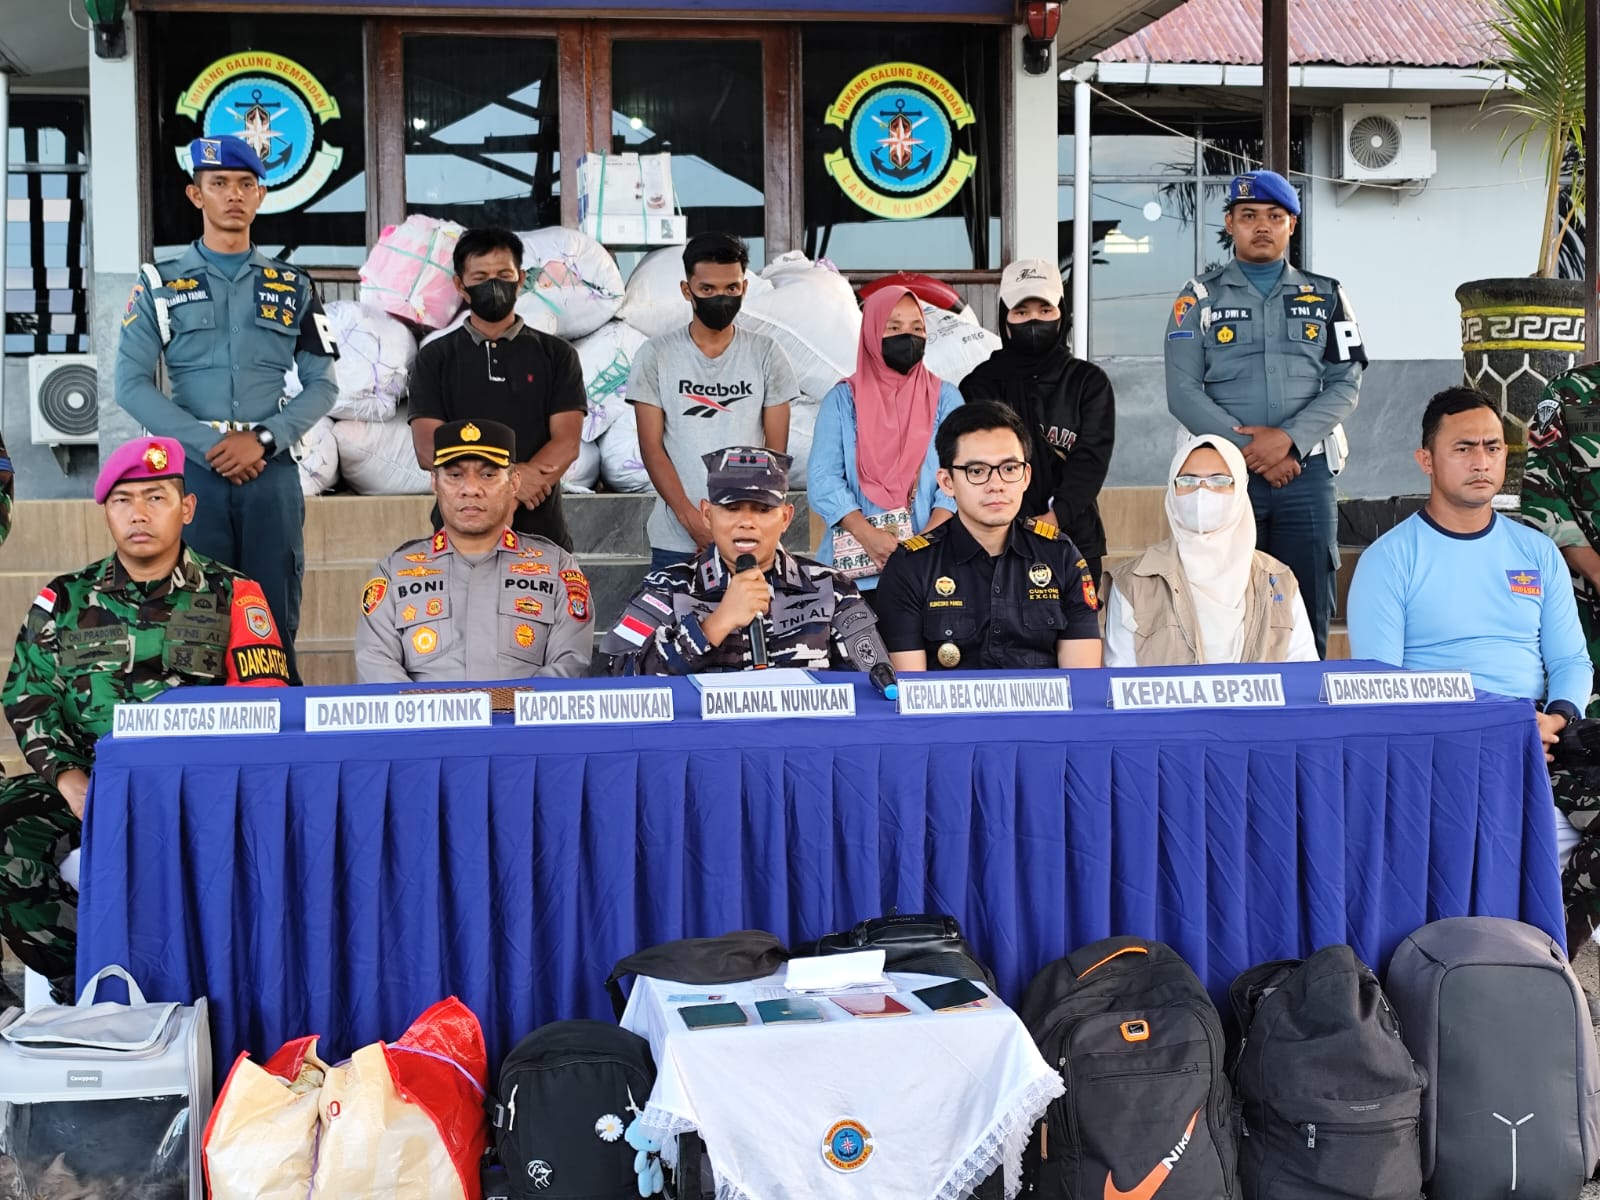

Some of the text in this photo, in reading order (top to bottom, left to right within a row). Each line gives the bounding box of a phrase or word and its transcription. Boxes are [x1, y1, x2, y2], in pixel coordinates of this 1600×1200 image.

[190, 57, 326, 109] MIKANG GALUNG SEMPADAN
[838, 67, 964, 116] MIKANG GALUNG SEMPADAN
[842, 175, 959, 215] LANAL NUNUKAN
[258, 291, 297, 311] TNI AL
[1290, 307, 1328, 320] TNI AL
[312, 313, 337, 353] P
[1334, 321, 1362, 361] P
[678, 380, 753, 397] Reebok
[397, 580, 444, 599] BONI
[505, 579, 554, 595] POLRI
[779, 607, 831, 629] TNI AL
[706, 688, 849, 715] DANLANAL NUNUKAN
[905, 681, 1064, 710] KEPALA BEA CUKAI NUNUKAN
[1122, 678, 1280, 706] KEPALA BP3MI
[1333, 676, 1471, 701] DANSATGAS KOPASKA
[117, 705, 277, 732] DANKI SATGAS MARINIR
[317, 698, 482, 726] DANDIM 0911/NNK
[519, 692, 671, 721] KAPOLRES NUNUKAN
[1161, 1131, 1191, 1171] NIKE
